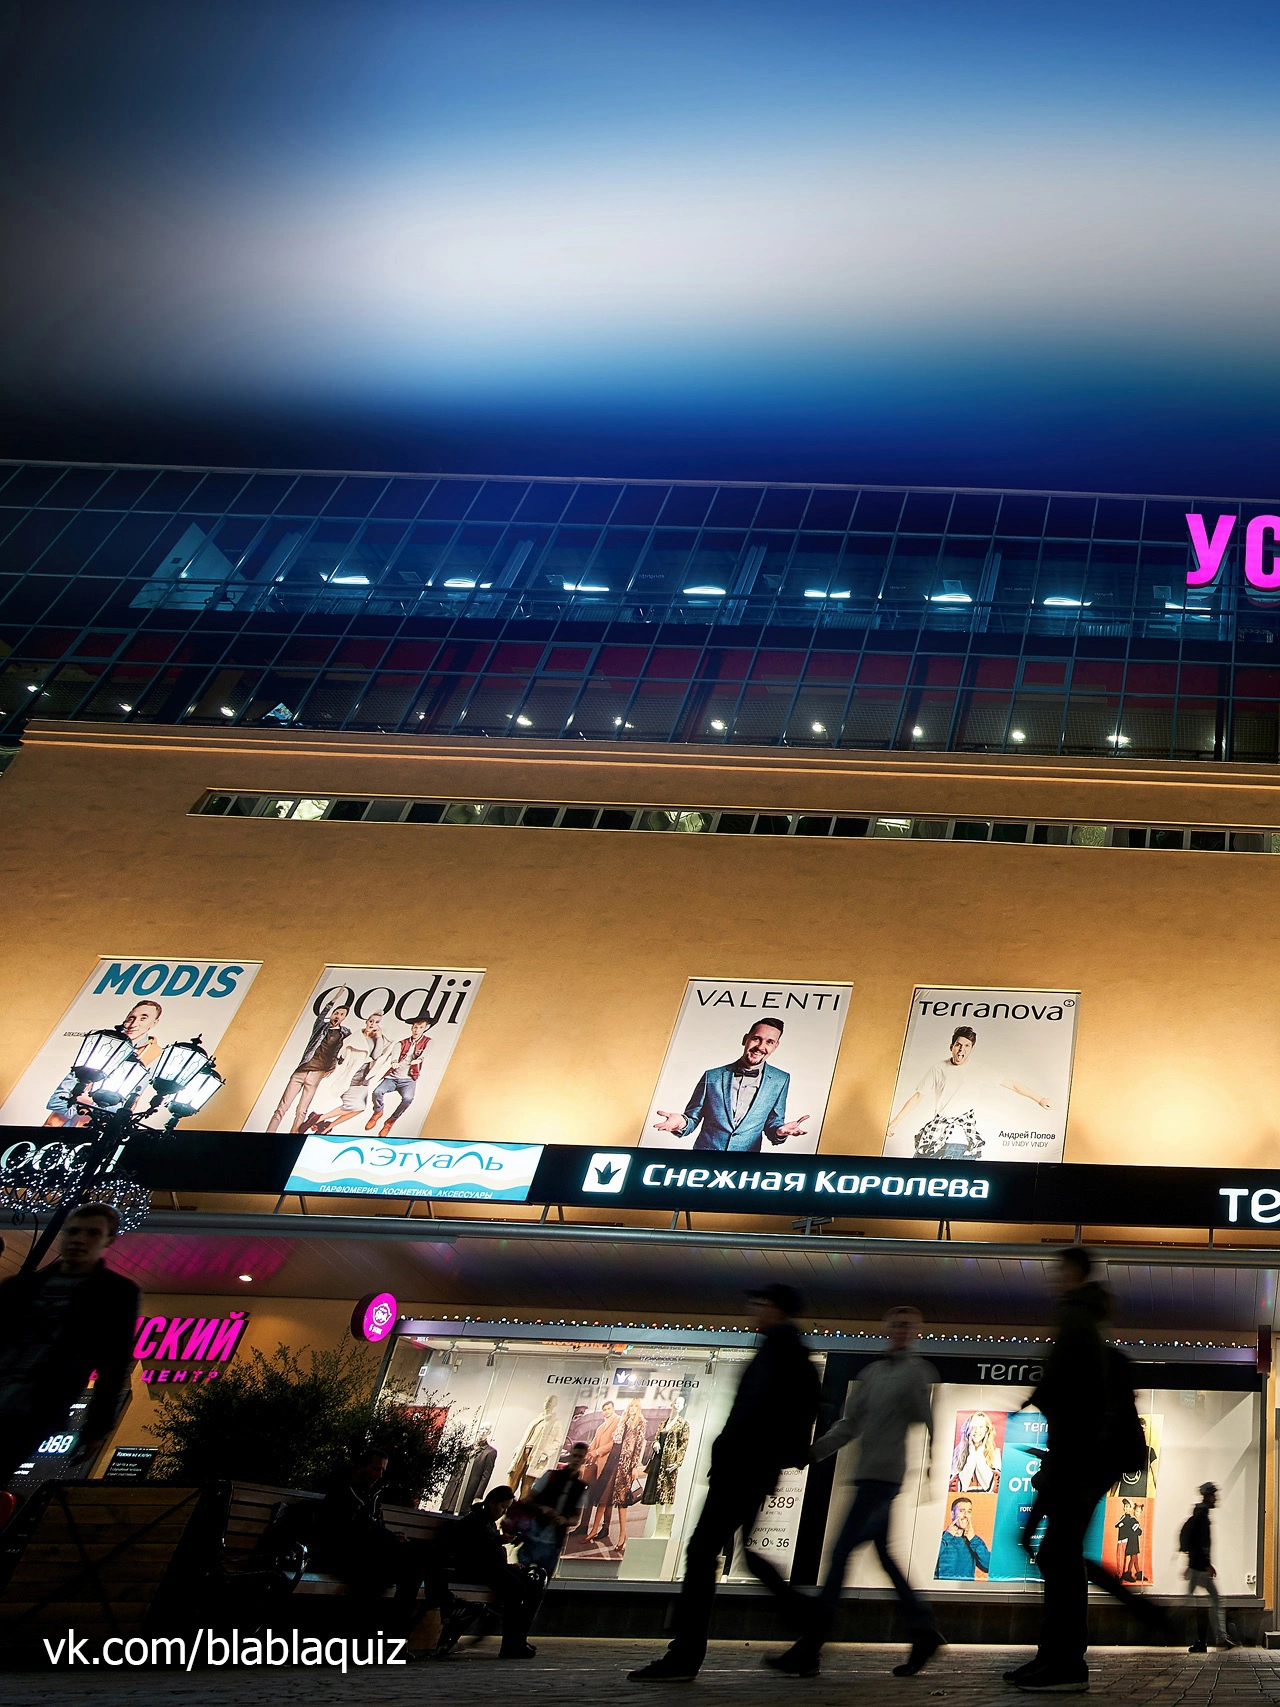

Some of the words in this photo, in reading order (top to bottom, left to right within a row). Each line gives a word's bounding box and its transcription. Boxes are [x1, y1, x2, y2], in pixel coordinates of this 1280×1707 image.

[93, 963, 244, 998] MODIS
[312, 974, 472, 1027] oodji
[697, 988, 840, 1012] VALENTI
[998, 1130, 1029, 1140] Андрей
[1030, 1131, 1056, 1140] Попов
[319, 1185, 379, 1194] ПАРФЮМЕРИЯ
[382, 1187, 433, 1197] КОСМЕТИКА
[436, 1190, 493, 1199] АКСЕССУАРЫ
[133, 1311, 244, 1361] СКИЙ
[141, 1369, 219, 1383] ЦЕНТР
[776, 1538, 790, 1548] 36
